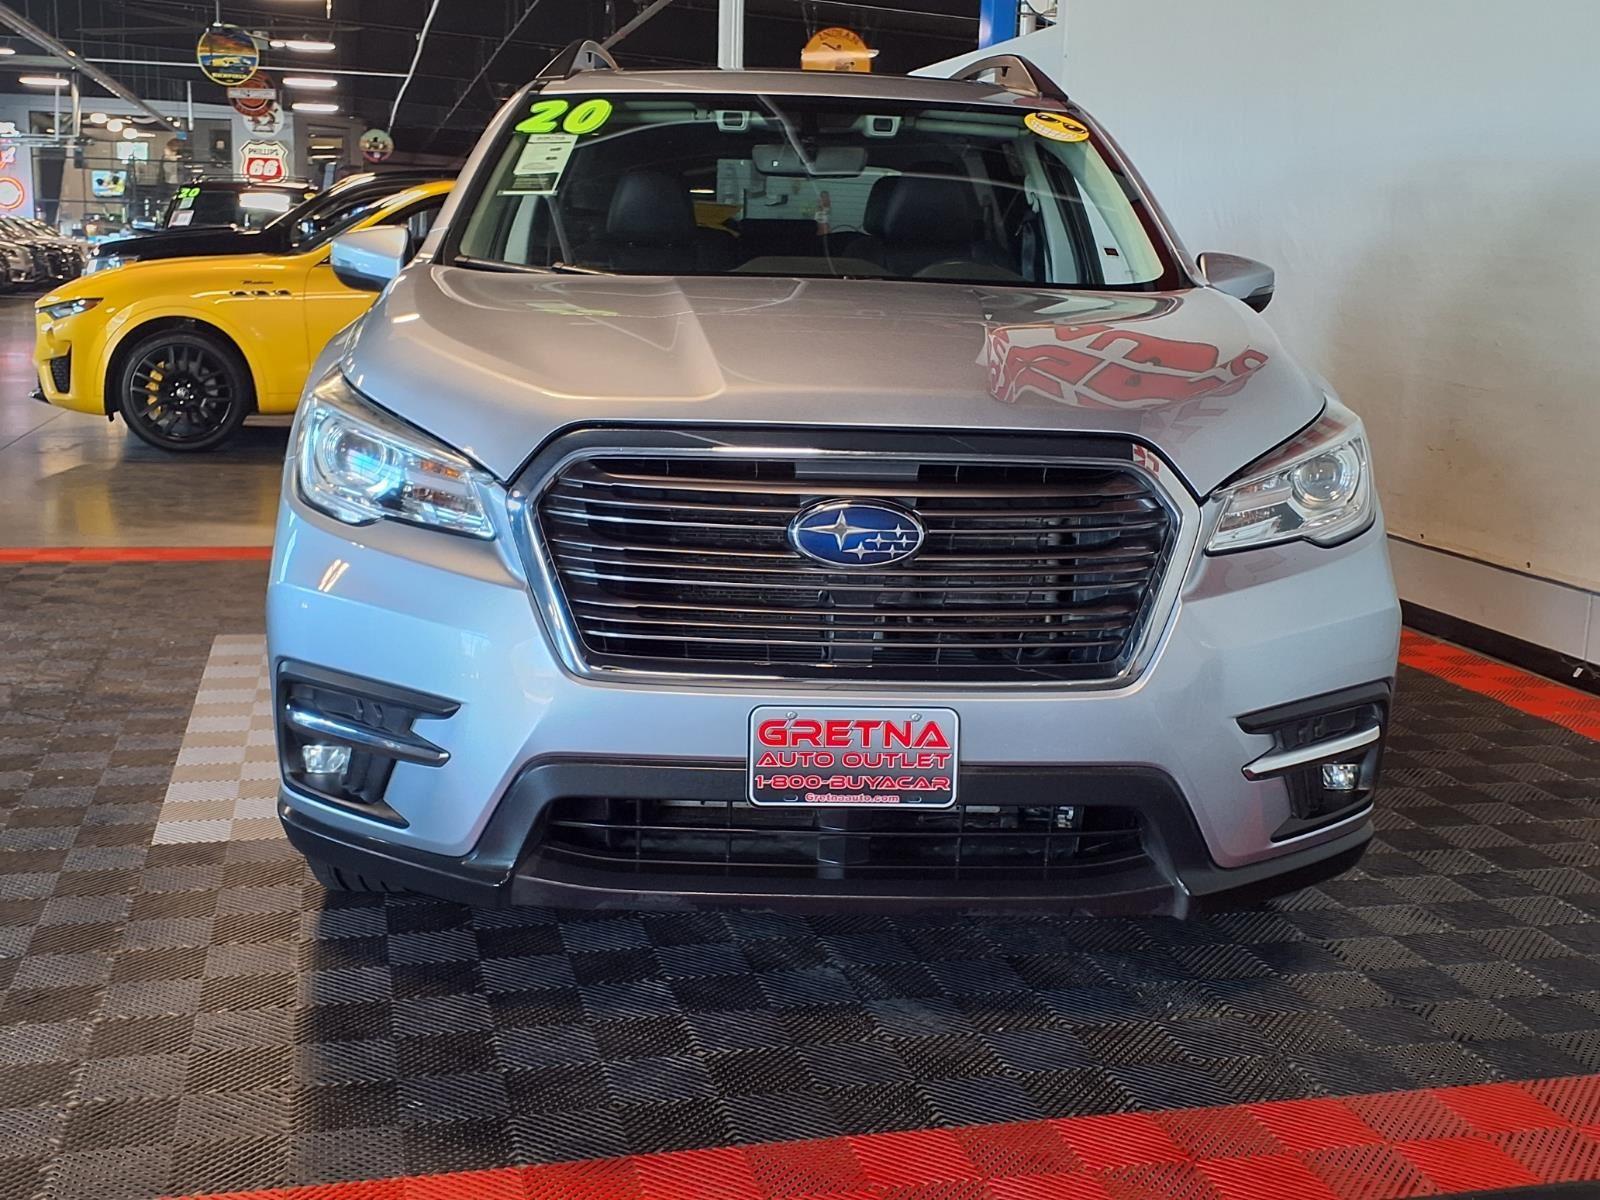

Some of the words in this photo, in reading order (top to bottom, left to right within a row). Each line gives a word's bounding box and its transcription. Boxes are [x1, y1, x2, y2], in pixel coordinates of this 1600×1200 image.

[515, 99, 613, 135] 20
[249, 159, 279, 176] 66
[178, 187, 201, 198] 20
[757, 719, 951, 749] GRETNA
[756, 751, 835, 769] AUTO
[841, 752, 952, 770] OUTLET
[755, 775, 951, 791] 1-800-BUYACAR
[804, 792, 900, 804] Gretnaauto.com
